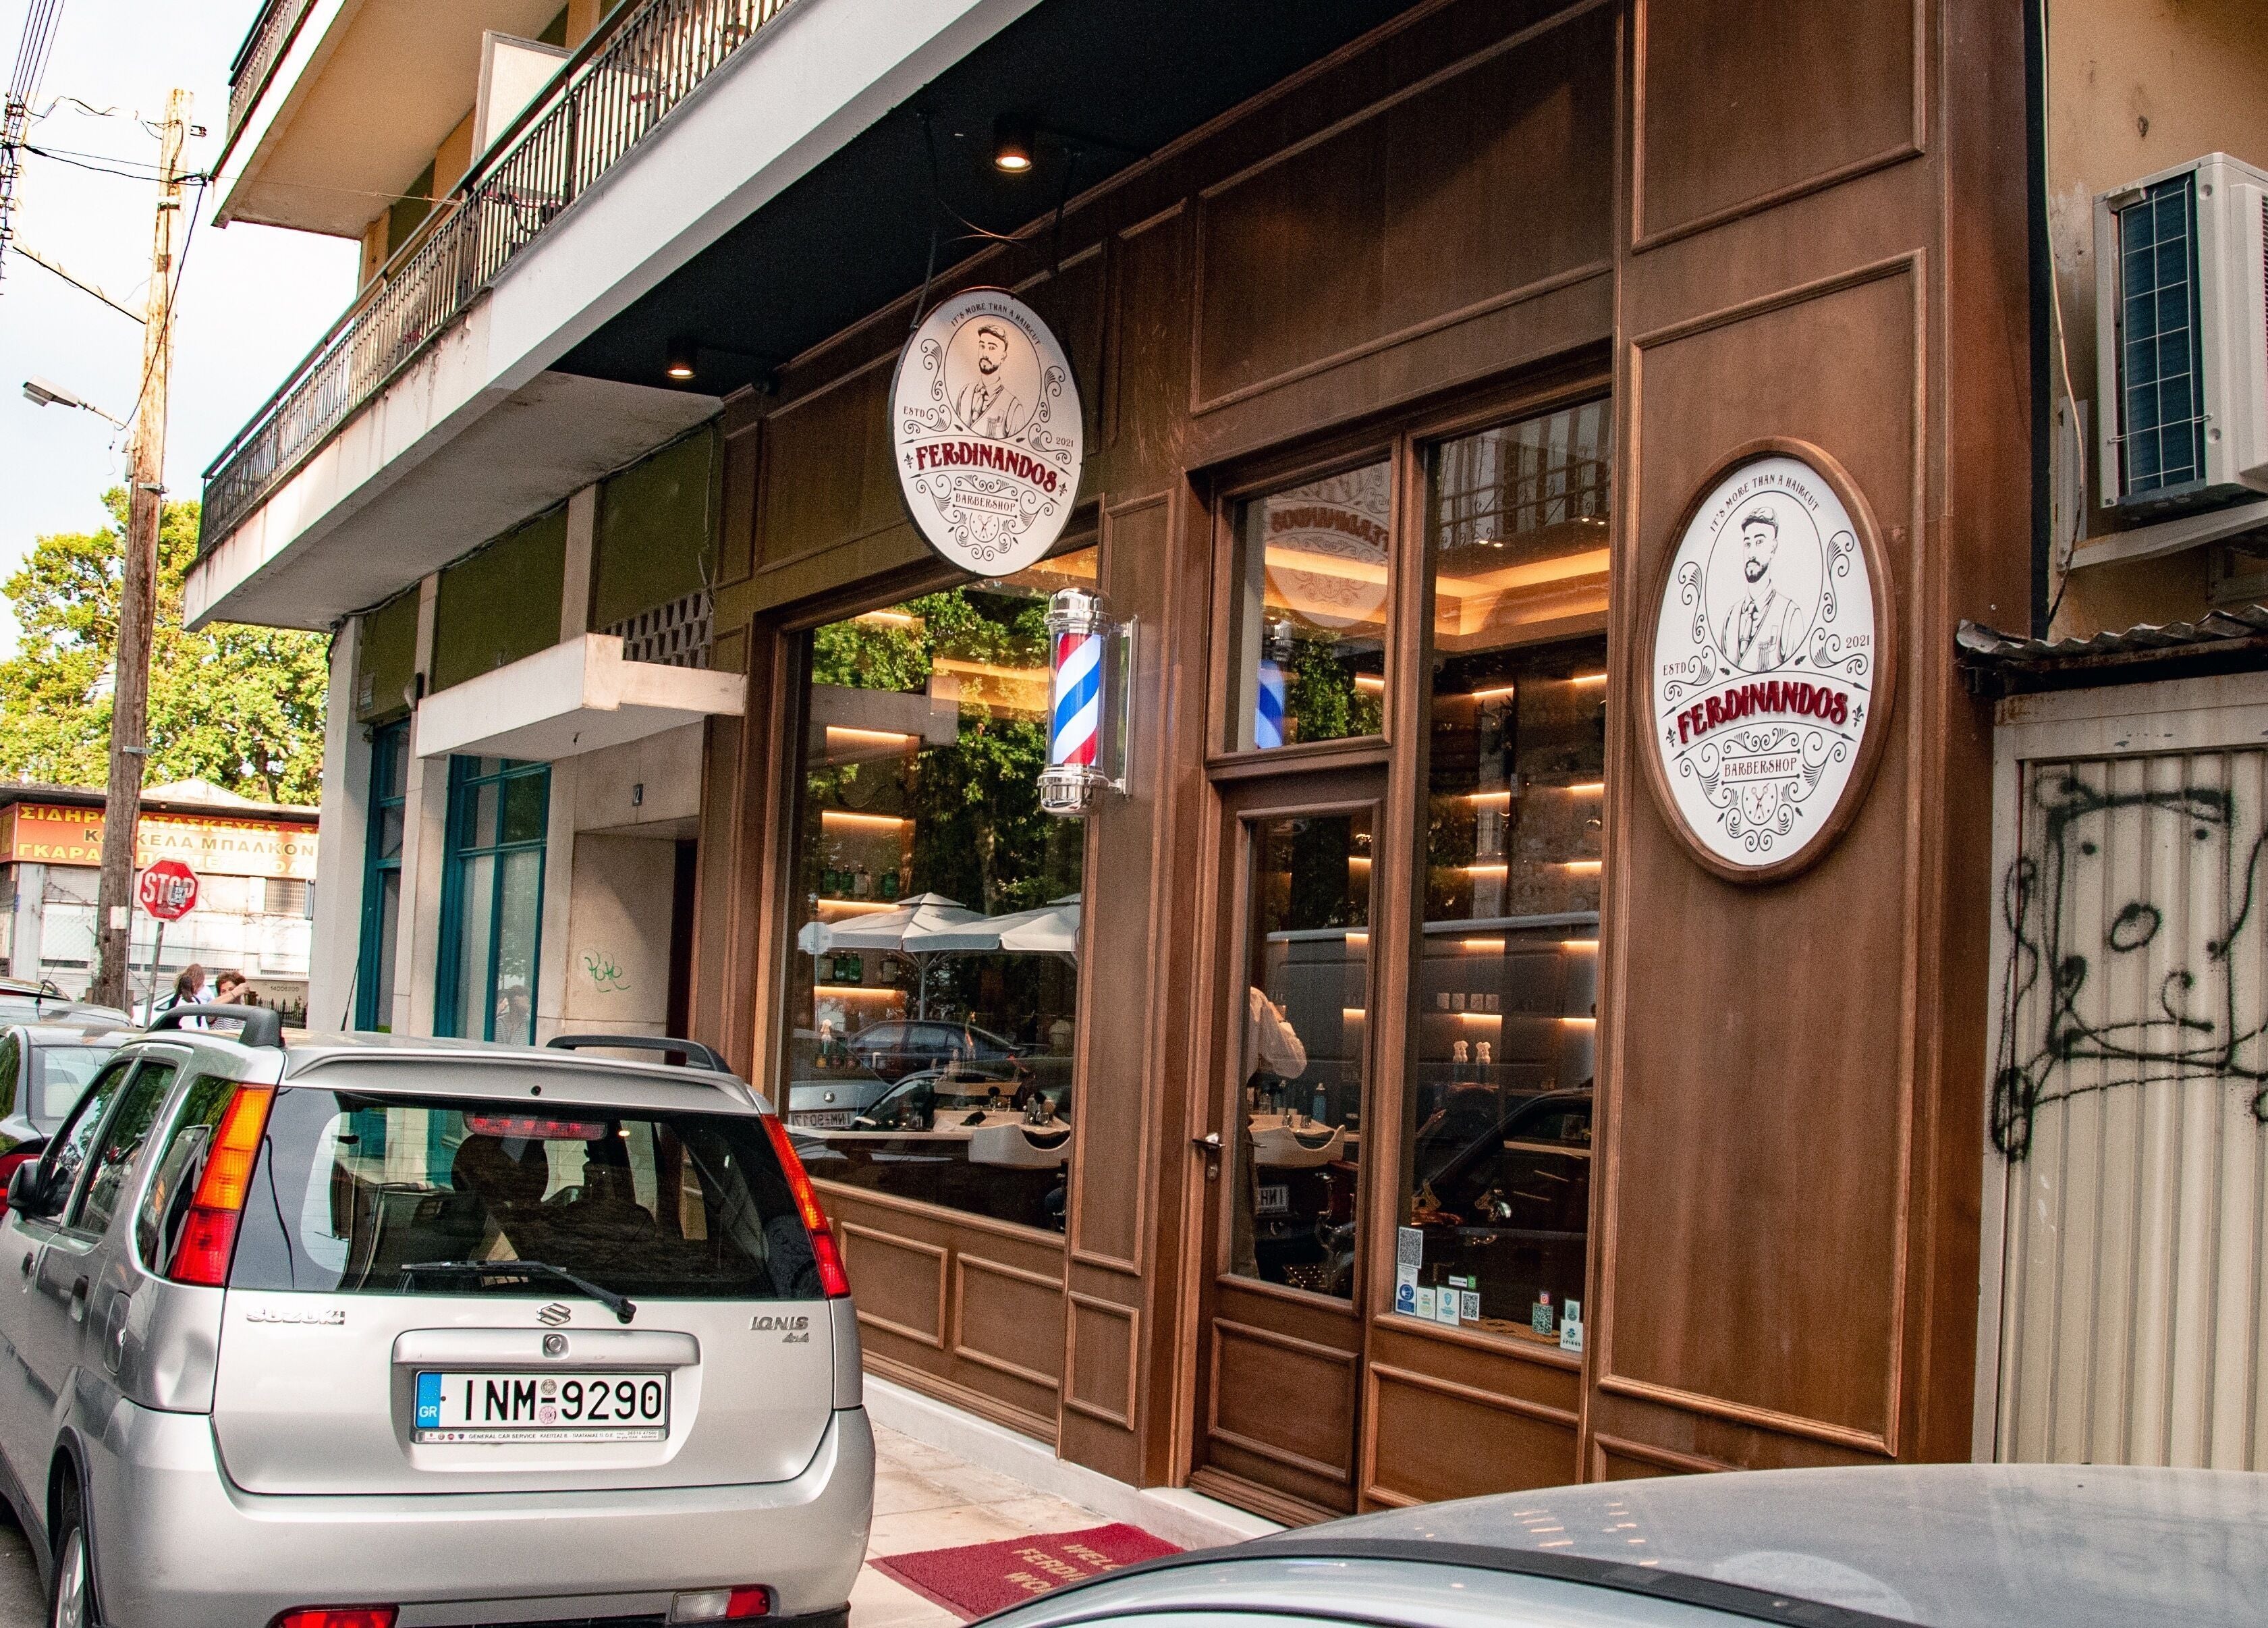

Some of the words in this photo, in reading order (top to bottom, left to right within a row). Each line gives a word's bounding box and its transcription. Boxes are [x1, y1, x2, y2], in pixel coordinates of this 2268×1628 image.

[951, 313, 965, 327] IT'S
[965, 302, 985, 315] MORE
[989, 302, 1007, 313] THAN
[1016, 314, 1041, 345] HAIRCUT
[904, 406, 925, 418] ESTD
[1056, 437, 1074, 447] 2021
[915, 441, 1058, 493] FERDINANDOS
[956, 493, 1016, 512] BARBERSHOP
[1710, 509, 1725, 532] IT'S
[1725, 482, 1750, 508] MORE
[1752, 474, 1775, 488] THAN
[1778, 474, 1783, 485] A
[1786, 477, 1819, 512] HAIRCUT
[1846, 634, 1870, 649] 2021
[1663, 663, 1686, 676] ESTD
[1677, 680, 1848, 744] FERDINANDOS
[1725, 757, 1798, 777] BARBERSHOP
[142, 872, 195, 908] STOP
[749, 1316, 808, 1330] IGNIS
[419, 1407, 437, 1418] GR
[466, 1380, 662, 1421] INM-9290
[1012, 1548, 1090, 1581] FERDI
[1061, 1544, 1123, 1571] WELC
